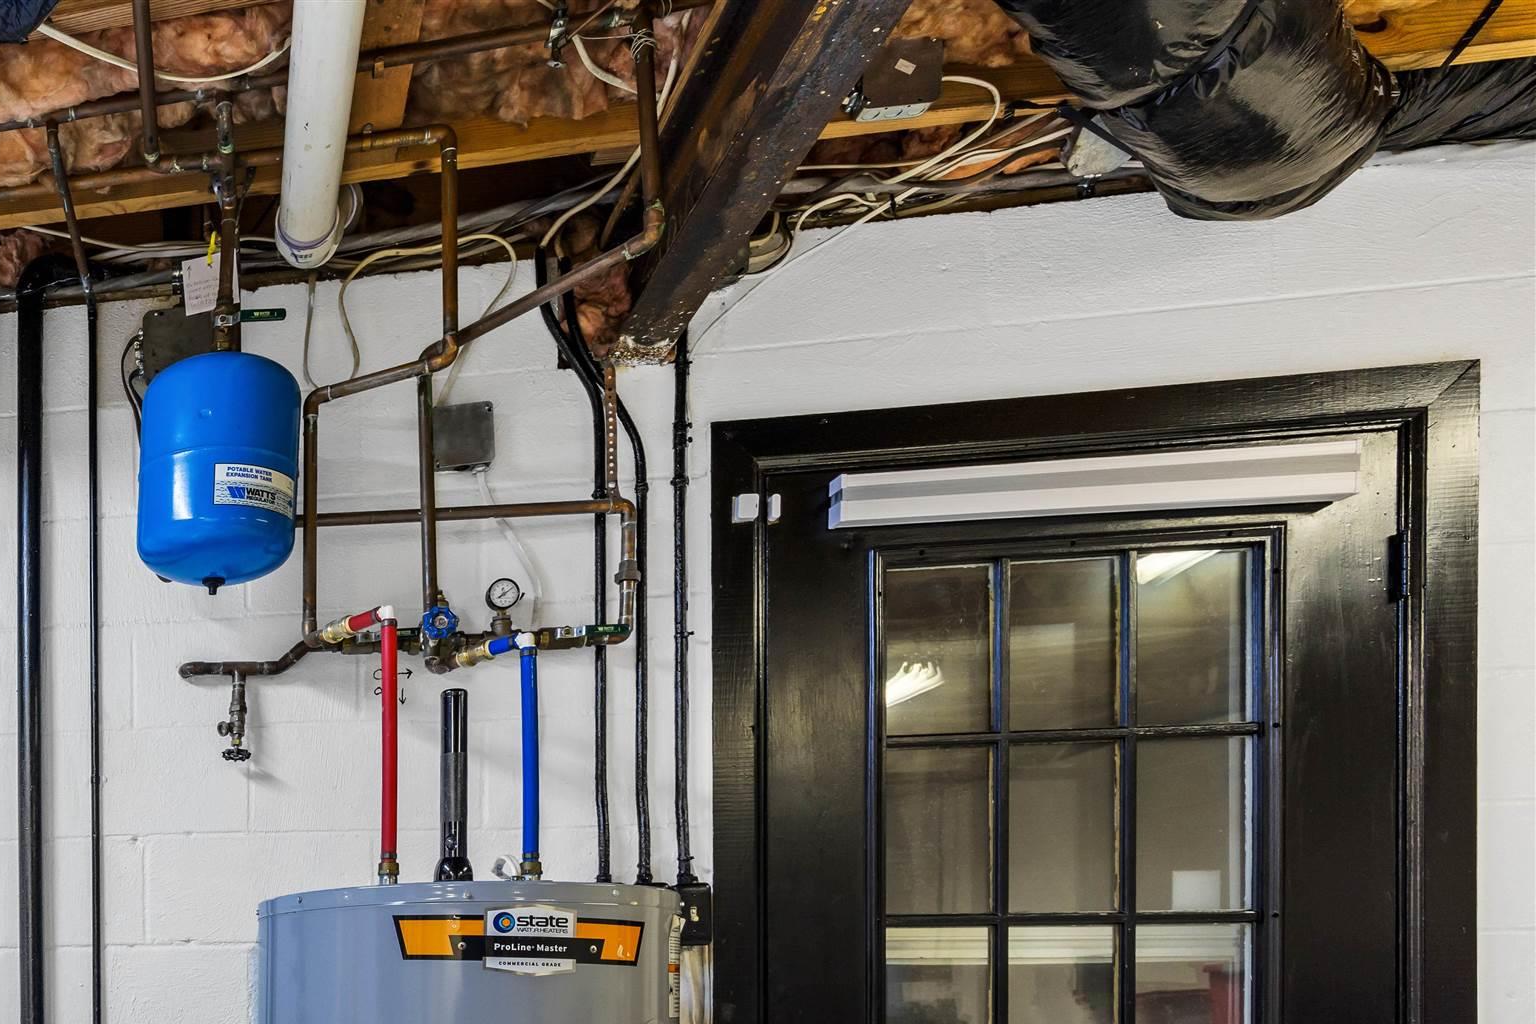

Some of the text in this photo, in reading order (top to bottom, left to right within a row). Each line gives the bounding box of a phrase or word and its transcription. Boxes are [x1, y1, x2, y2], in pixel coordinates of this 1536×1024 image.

[226, 472, 258, 480] EXPANSION
[255, 468, 272, 477] WATER
[246, 487, 276, 500] WATTS
[516, 915, 568, 928] state
[536, 944, 568, 952] Master
